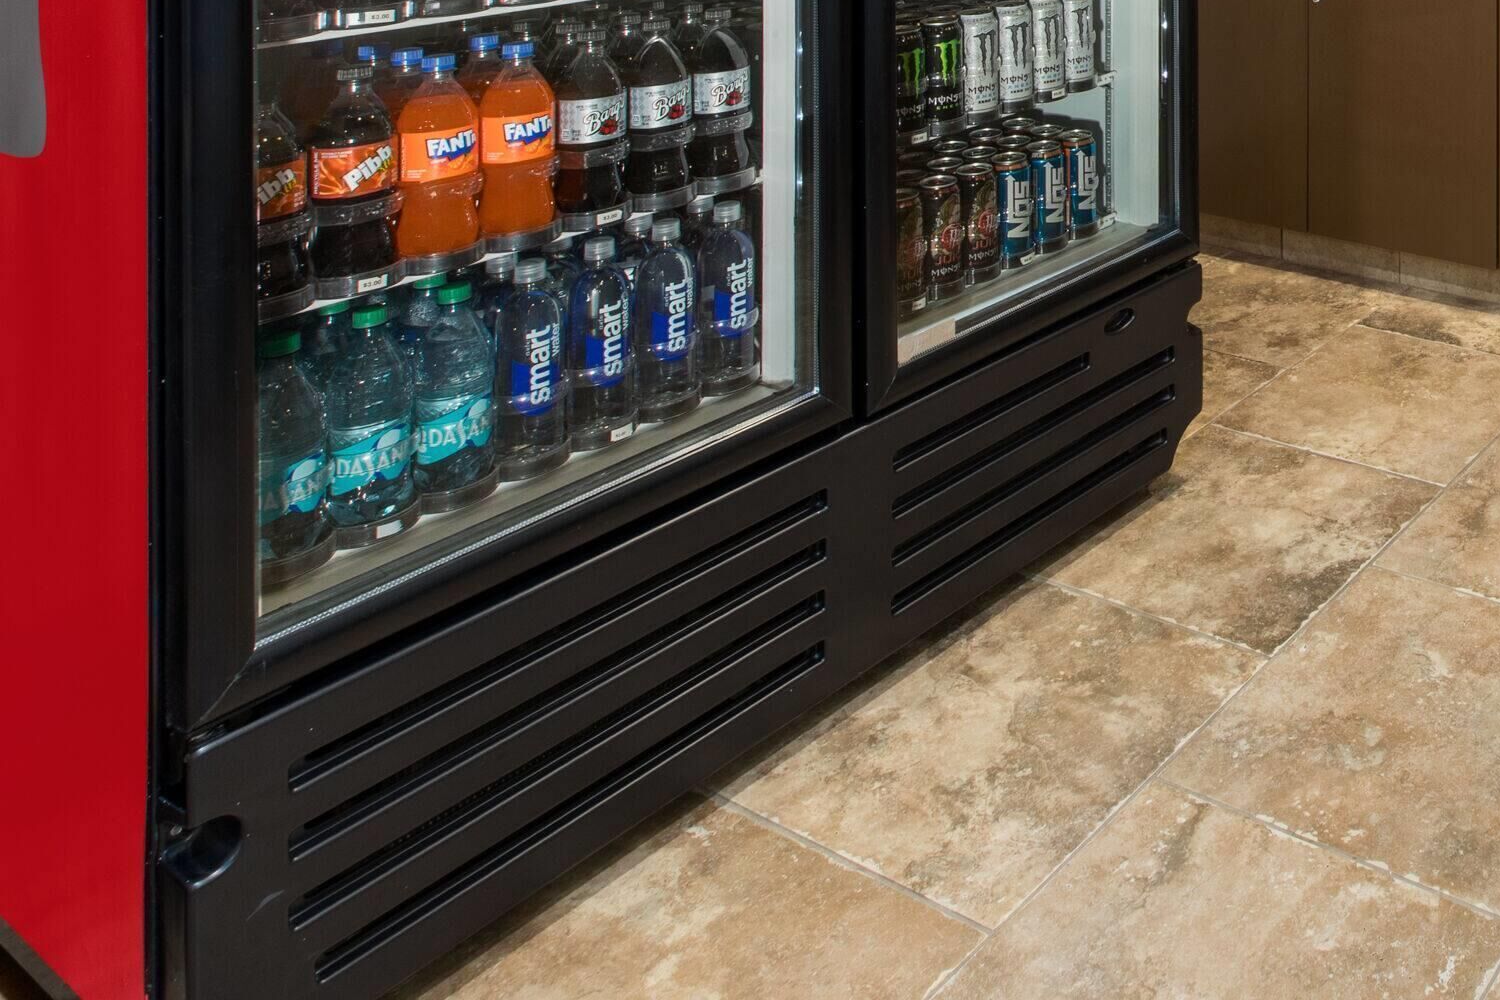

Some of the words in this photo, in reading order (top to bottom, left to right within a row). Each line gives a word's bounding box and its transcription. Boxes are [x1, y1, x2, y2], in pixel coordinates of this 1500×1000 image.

[1000, 73, 1030, 85] MONS
[1035, 63, 1063, 75] MONS
[928, 94, 960, 106] MONS
[967, 84, 997, 95] MONS
[257, 167, 296, 205] ibb
[341, 144, 392, 192] Pibb
[1075, 150, 1099, 211] NOS
[1004, 174, 1030, 239] NOS
[1042, 161, 1065, 224] NOS
[746, 257, 755, 288] water
[686, 276, 694, 309] water
[727, 258, 747, 330] smart
[621, 297, 630, 332] water
[666, 279, 687, 354] smart
[550, 322, 561, 357] water
[599, 299, 623, 377] smart
[525, 324, 551, 406] smart
[334, 446, 408, 477] DASAN
